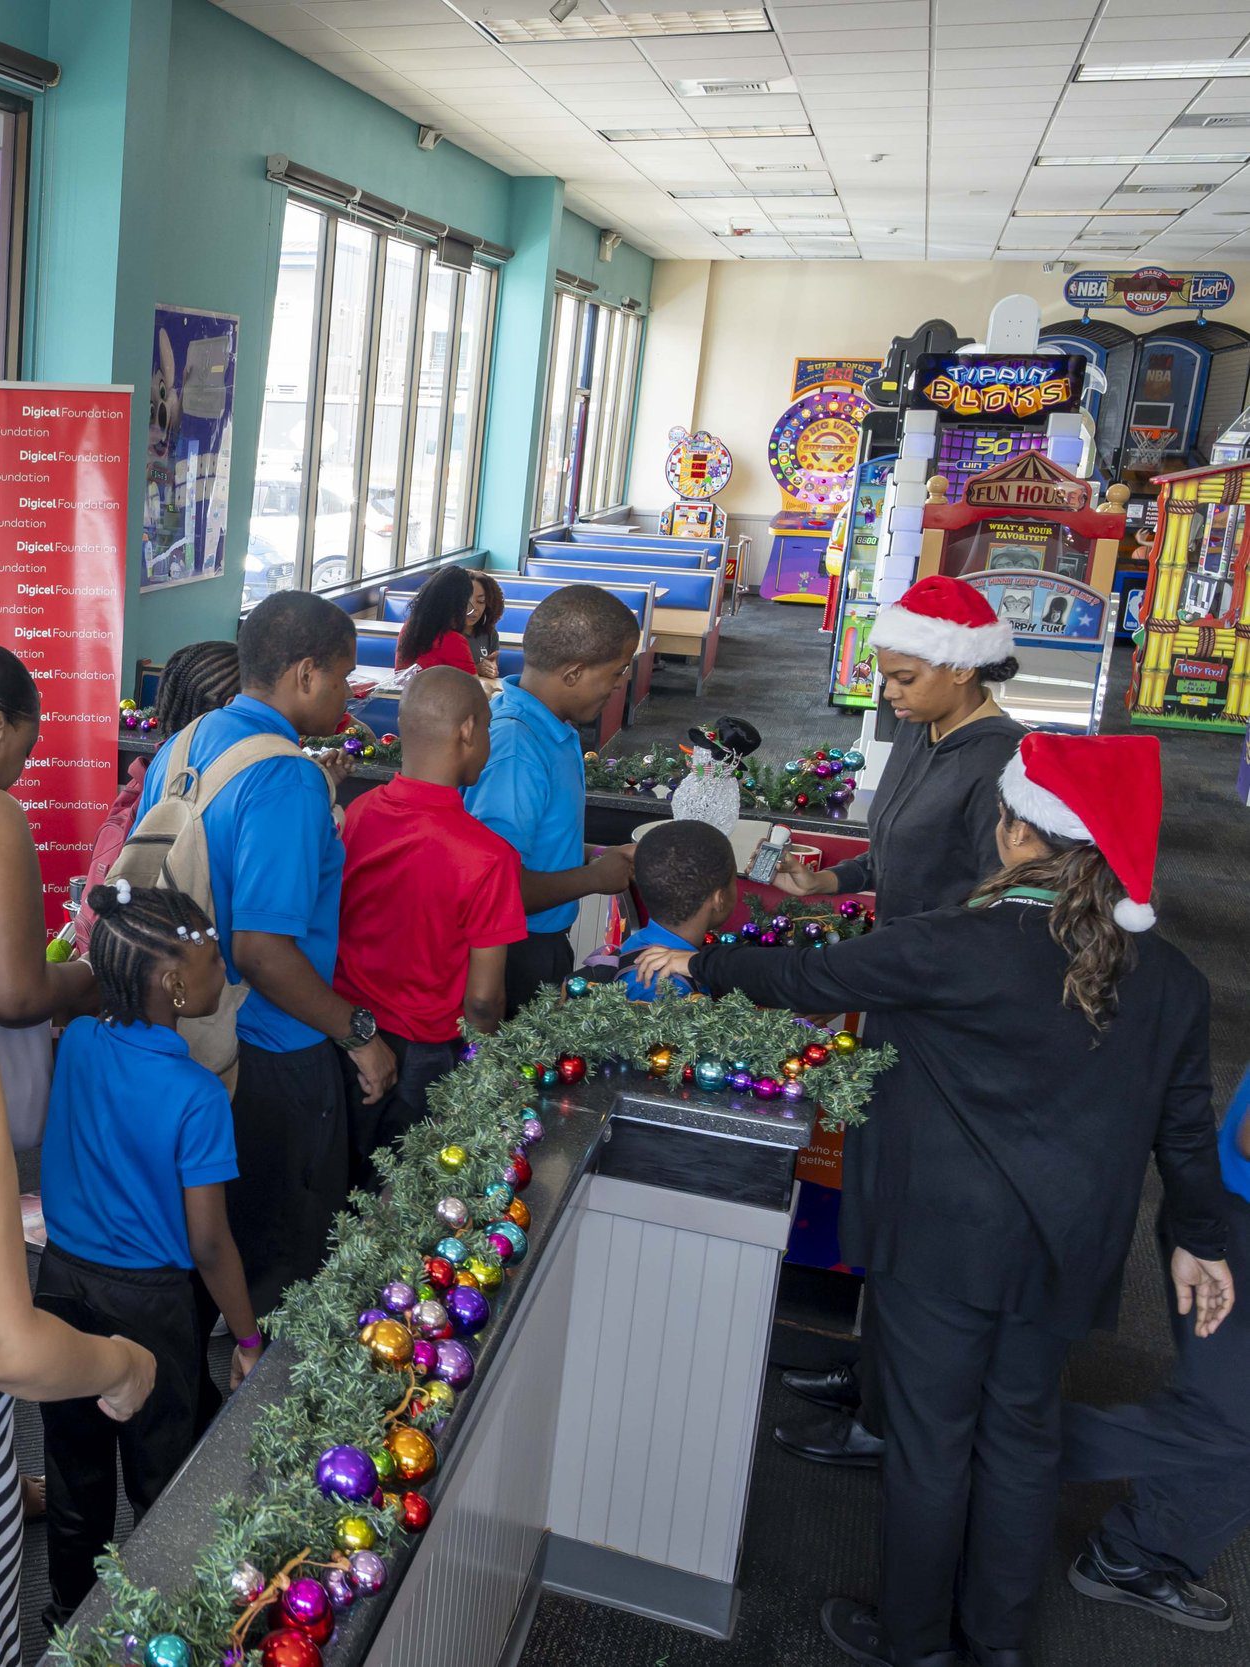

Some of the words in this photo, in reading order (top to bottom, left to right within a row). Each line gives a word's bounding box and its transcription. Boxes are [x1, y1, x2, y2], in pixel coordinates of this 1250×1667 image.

[1078, 280, 1108, 298] NBA
[1190, 278, 1228, 303] Hoops
[1126, 292, 1168, 302] BONUS
[807, 362, 836, 372] SUPER
[842, 362, 874, 374] BONUS
[1146, 369, 1171, 382] NBA
[930, 378, 1066, 412] BLOKS
[809, 421, 828, 436] BIG
[833, 421, 856, 436] WIN
[976, 437, 1012, 456] 50
[976, 486, 1009, 502] FUN
[988, 523, 1024, 532] WHAT'S
[1028, 526, 1053, 535] YOUR
[1041, 624, 1066, 634] FUN!
[54, 670, 115, 680] Foundation
[1178, 664, 1202, 674] TASTY
[52, 712, 111, 723] Foundation
[25, 758, 50, 769] gicel
[52, 758, 110, 768] Foundation
[20, 800, 48, 811] igicel
[49, 800, 108, 810] Foundation
[50, 842, 93, 851] Foundat
[807, 1145, 830, 1155] who
[800, 1154, 836, 1168] gether.
